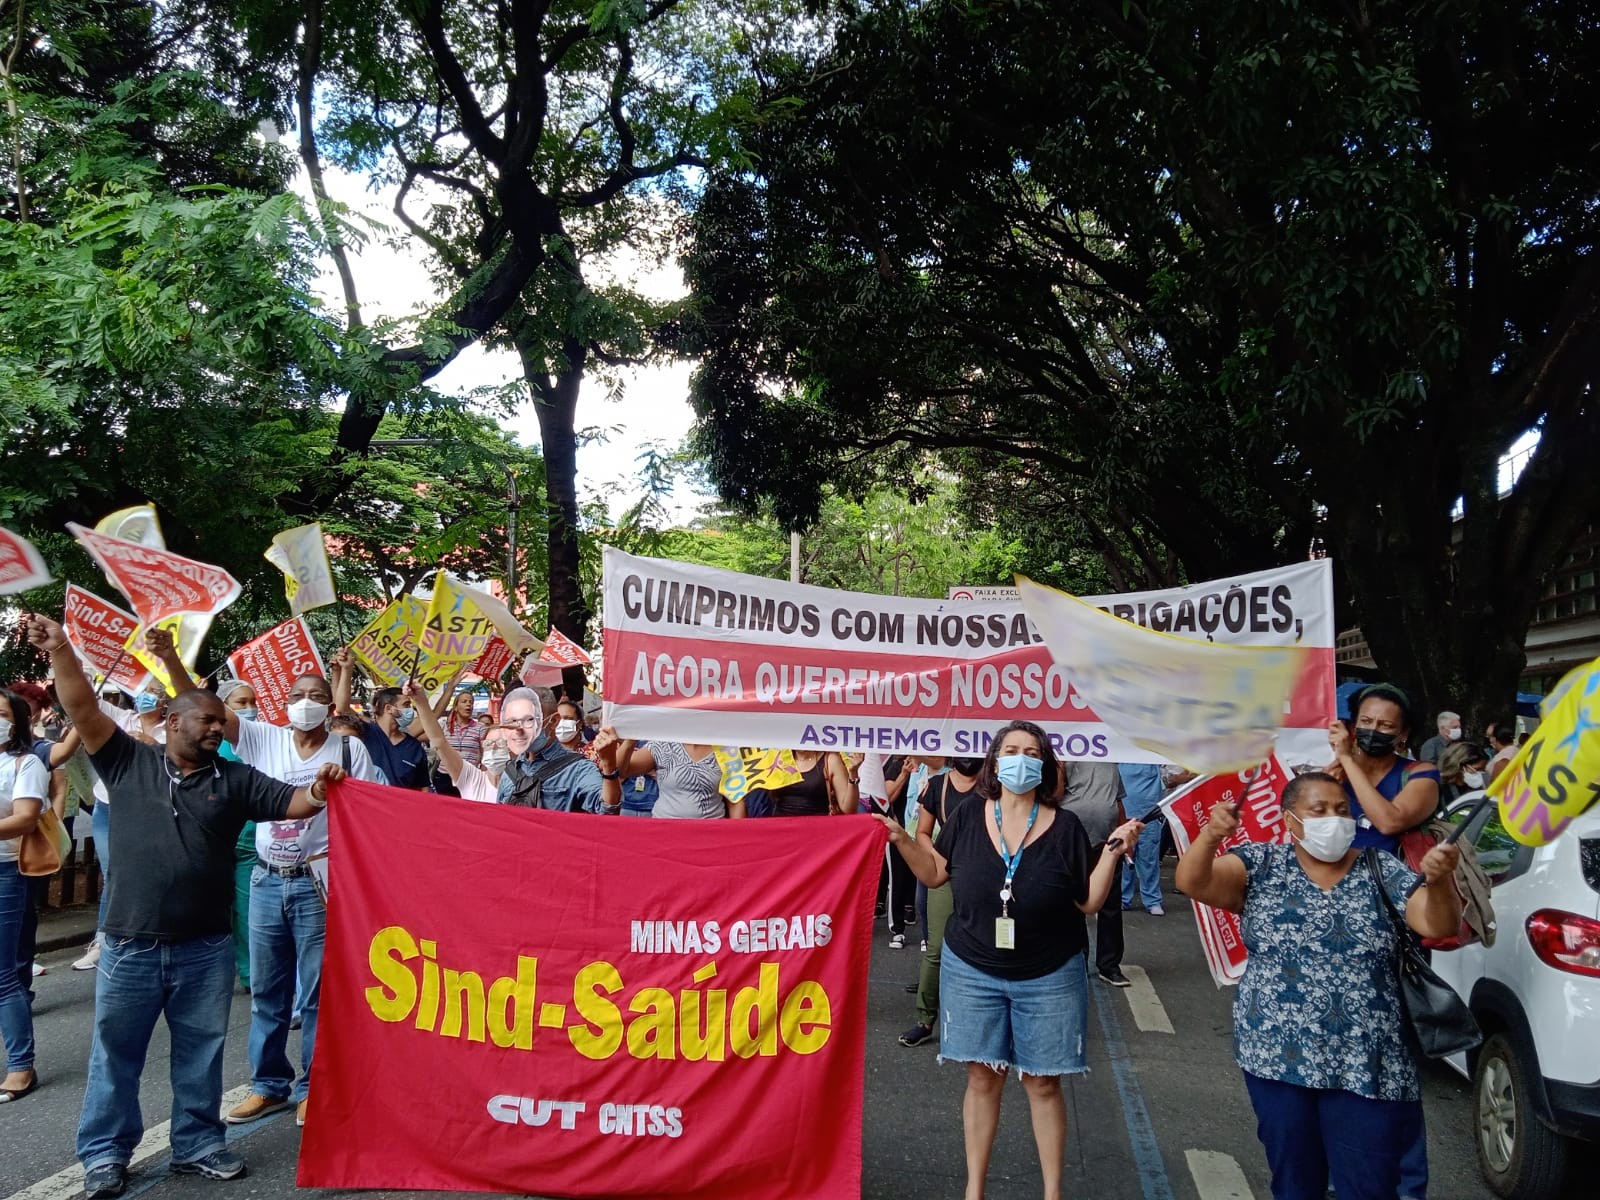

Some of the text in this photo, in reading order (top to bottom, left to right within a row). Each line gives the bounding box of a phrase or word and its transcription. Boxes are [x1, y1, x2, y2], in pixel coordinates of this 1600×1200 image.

[67, 593, 132, 638] Sind-Sa
[622, 574, 820, 638] CUMPRIMOS
[831, 607, 904, 644] COM
[1096, 584, 1304, 643] RIGAÇÕES,
[274, 623, 314, 679] Sind-S
[630, 651, 744, 701] AGORA
[755, 661, 939, 706] QUEREMOS
[800, 723, 941, 752] ASTHEMG
[954, 729, 1109, 758] SINROS
[630, 913, 833, 955] MINAS GERAIS
[364, 925, 832, 1062] Sind-Saúde
[486, 1094, 684, 1139] CUT CNTSS
